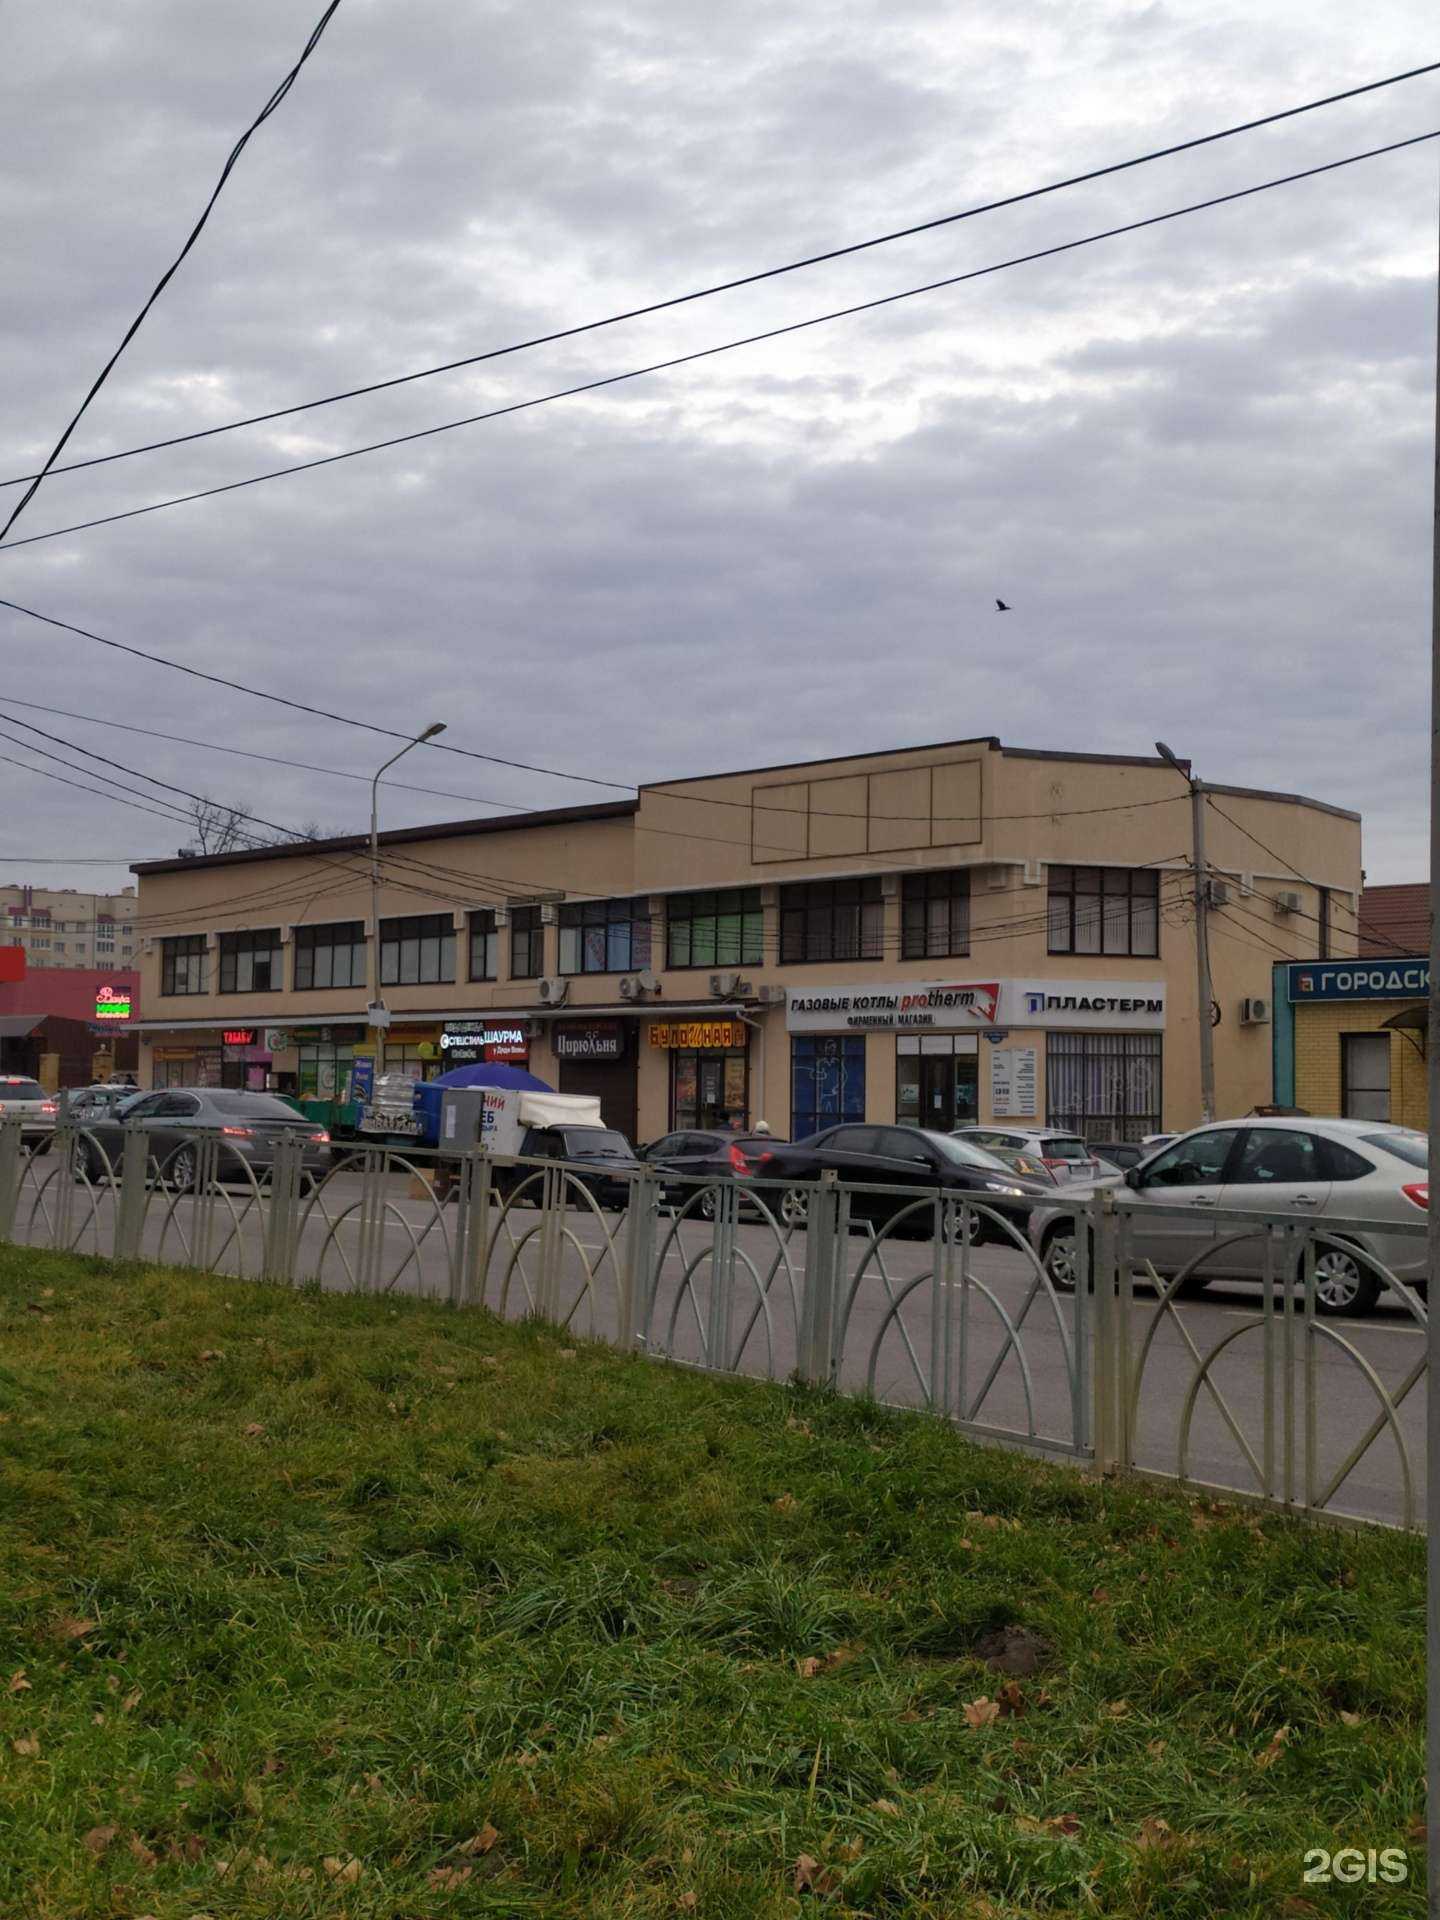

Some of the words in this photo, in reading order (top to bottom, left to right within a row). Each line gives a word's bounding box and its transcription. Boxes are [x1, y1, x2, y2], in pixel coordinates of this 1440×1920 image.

[791, 998, 850, 1011] ГАЗОВЫЕ
[852, 996, 898, 1009] КОТЛЫ
[901, 990, 975, 1011] protherm
[1047, 996, 1163, 1012] ПЛАСТЕРМ
[847, 1014, 894, 1026] ФИРМЕННЫЙ
[484, 1030, 523, 1044] ШАУРМА
